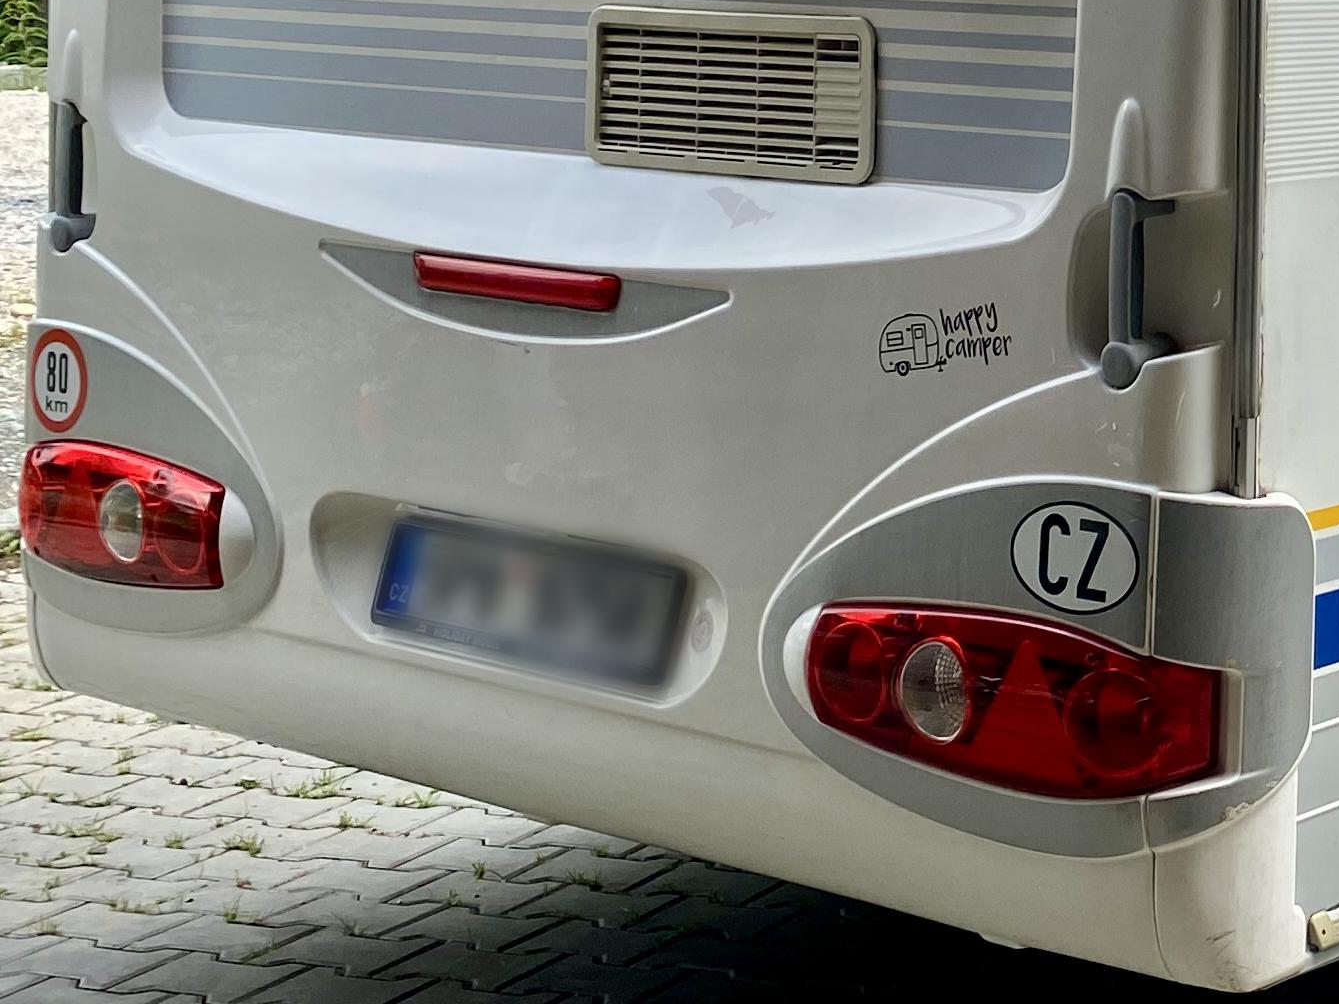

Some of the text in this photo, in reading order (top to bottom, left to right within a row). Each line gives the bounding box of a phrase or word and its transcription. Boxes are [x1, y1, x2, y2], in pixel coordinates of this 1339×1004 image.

[939, 302, 998, 336] happy
[945, 334, 1012, 366] camper
[46, 351, 68, 394] 80
[45, 396, 68, 414] km
[1038, 513, 1110, 603] CZ
[389, 582, 409, 604] CZ
